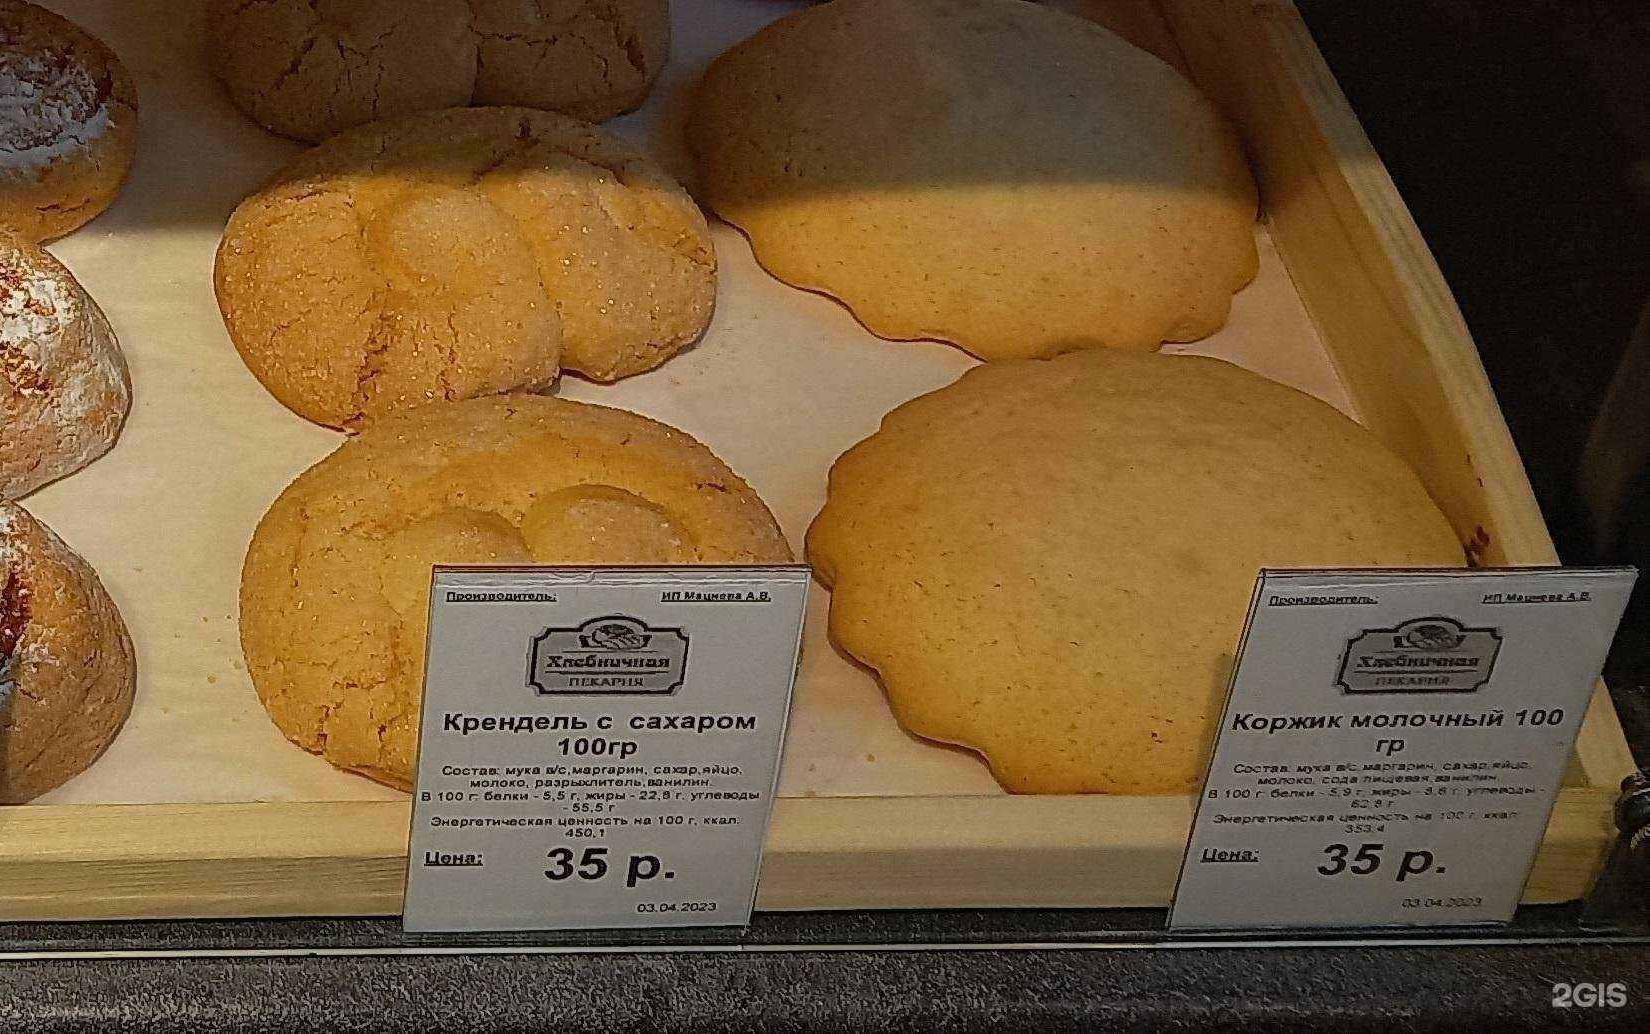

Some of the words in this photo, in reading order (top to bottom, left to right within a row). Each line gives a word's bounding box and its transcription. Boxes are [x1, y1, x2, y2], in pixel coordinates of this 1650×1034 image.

[446, 591, 557, 602] Производитель:
[661, 592, 681, 602] ИП
[546, 655, 670, 669] Хлебничная
[568, 677, 644, 688] ПЕКАРНЯ
[444, 713, 587, 734] Крендель
[597, 716, 612, 730] с
[629, 714, 756, 734] сахаром
[1232, 712, 1341, 733] Коржик
[1350, 709, 1503, 729] молочный
[1515, 709, 1564, 726] 100
[558, 738, 637, 759] 100гр
[1376, 737, 1406, 755] гр
[505, 767, 540, 777] мука
[470, 778, 529, 789] молоко,
[421, 792, 431, 801] В
[437, 792, 464, 801] 100
[484, 791, 529, 801] белки
[585, 792, 626, 802] жиры
[690, 791, 760, 801] углеводы
[1208, 789, 1218, 798] В
[1225, 789, 1250, 798] 100
[1270, 788, 1315, 798] белки
[431, 816, 552, 828] Энергетическая
[558, 816, 628, 827] ценность
[634, 817, 652, 825] на
[658, 816, 683, 825] 100
[424, 851, 484, 866] Цена:
[1200, 847, 1260, 863] Цена:
[544, 847, 609, 881] 35
[626, 853, 675, 887] р.
[1317, 843, 1383, 876] 35
[1396, 848, 1446, 882] р.
[637, 902, 717, 913] 03.04.2023
